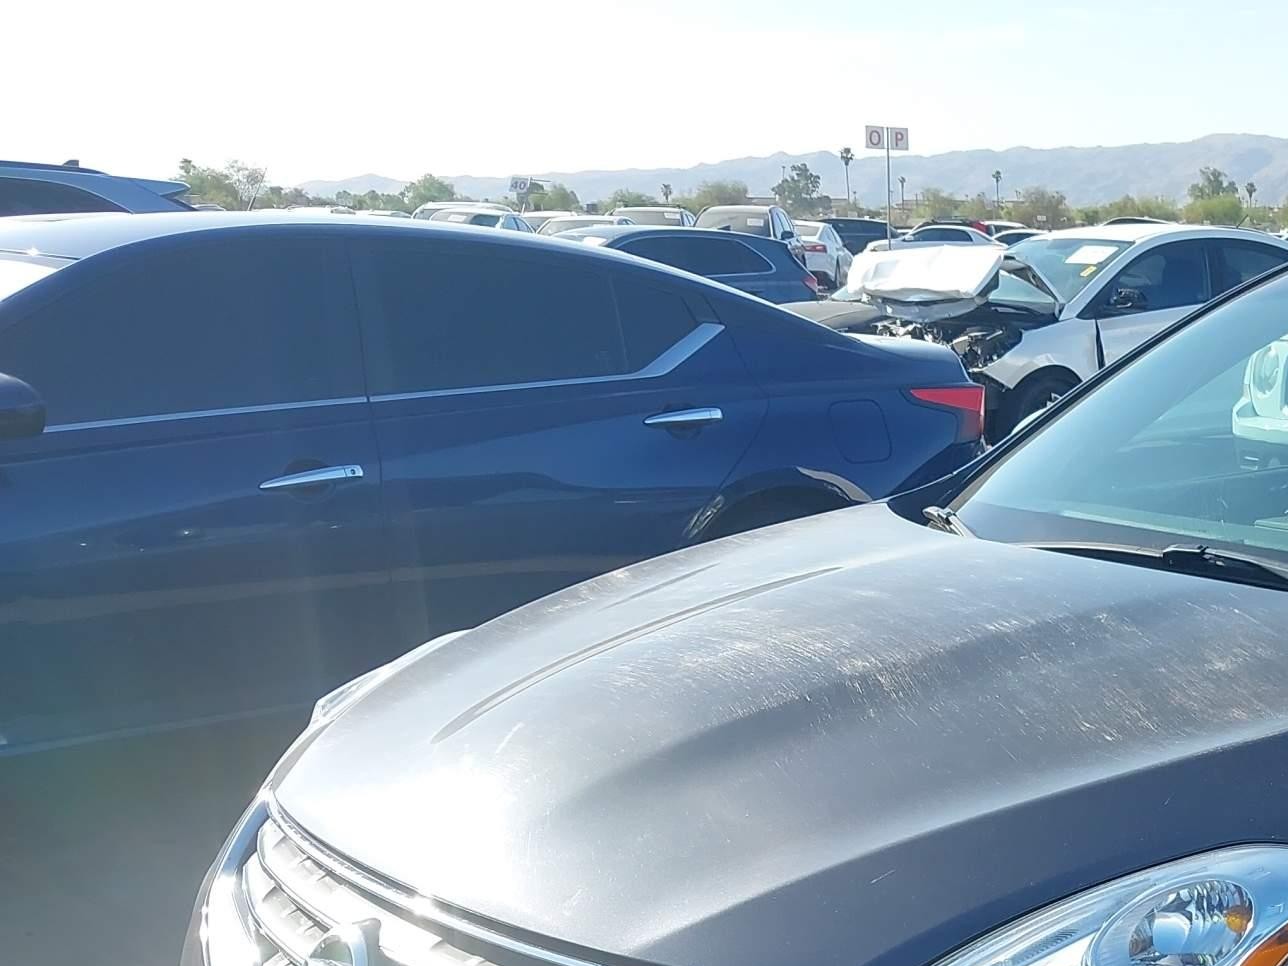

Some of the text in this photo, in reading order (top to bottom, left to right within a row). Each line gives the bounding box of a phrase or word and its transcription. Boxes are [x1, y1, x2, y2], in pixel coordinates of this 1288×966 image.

[869, 129, 905, 148] O P
[511, 180, 527, 191] 40
